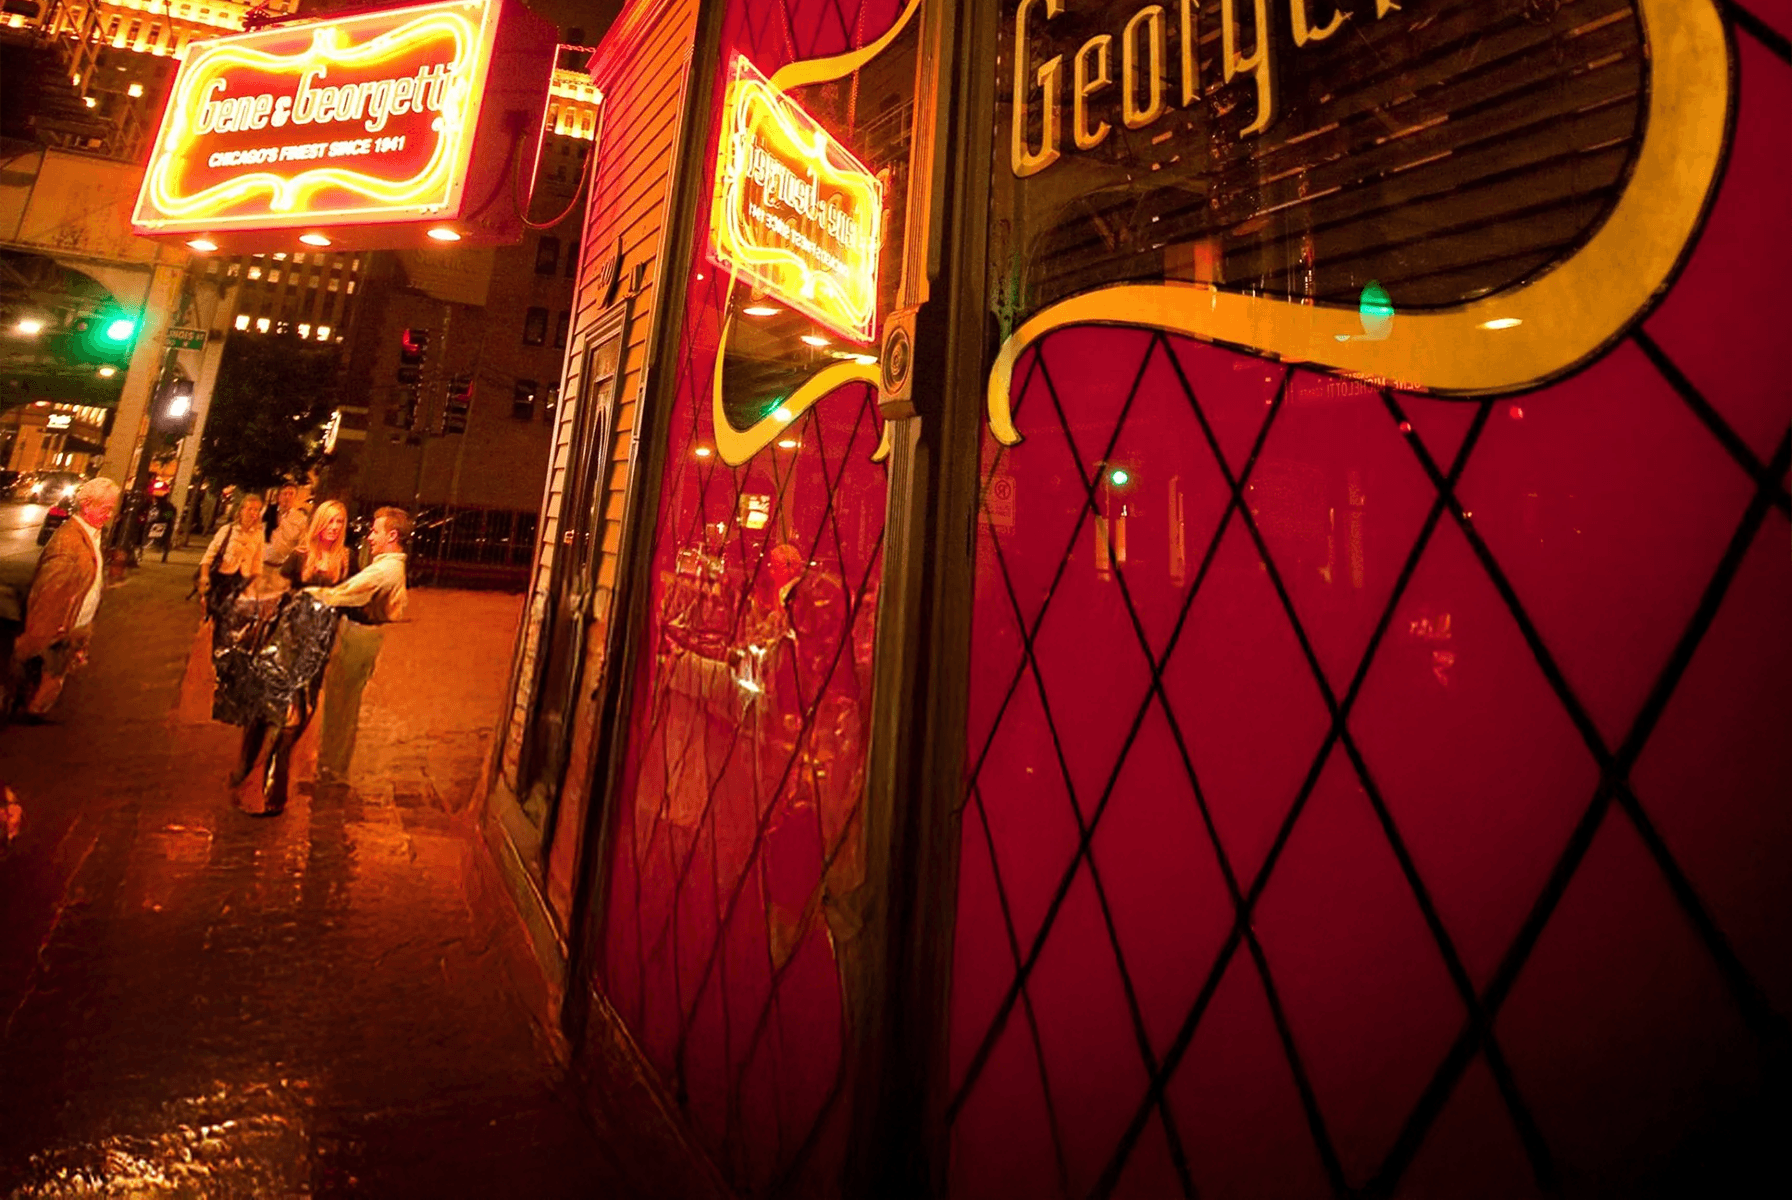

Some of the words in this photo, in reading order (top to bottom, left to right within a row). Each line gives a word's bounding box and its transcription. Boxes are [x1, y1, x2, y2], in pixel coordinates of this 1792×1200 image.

[193, 77, 272, 134] Gene
[271, 96, 291, 127] &
[209, 146, 279, 167] CHICAGO'S
[279, 142, 328, 161] FINEST
[328, 138, 372, 157] SINCE
[374, 135, 405, 153] 1941
